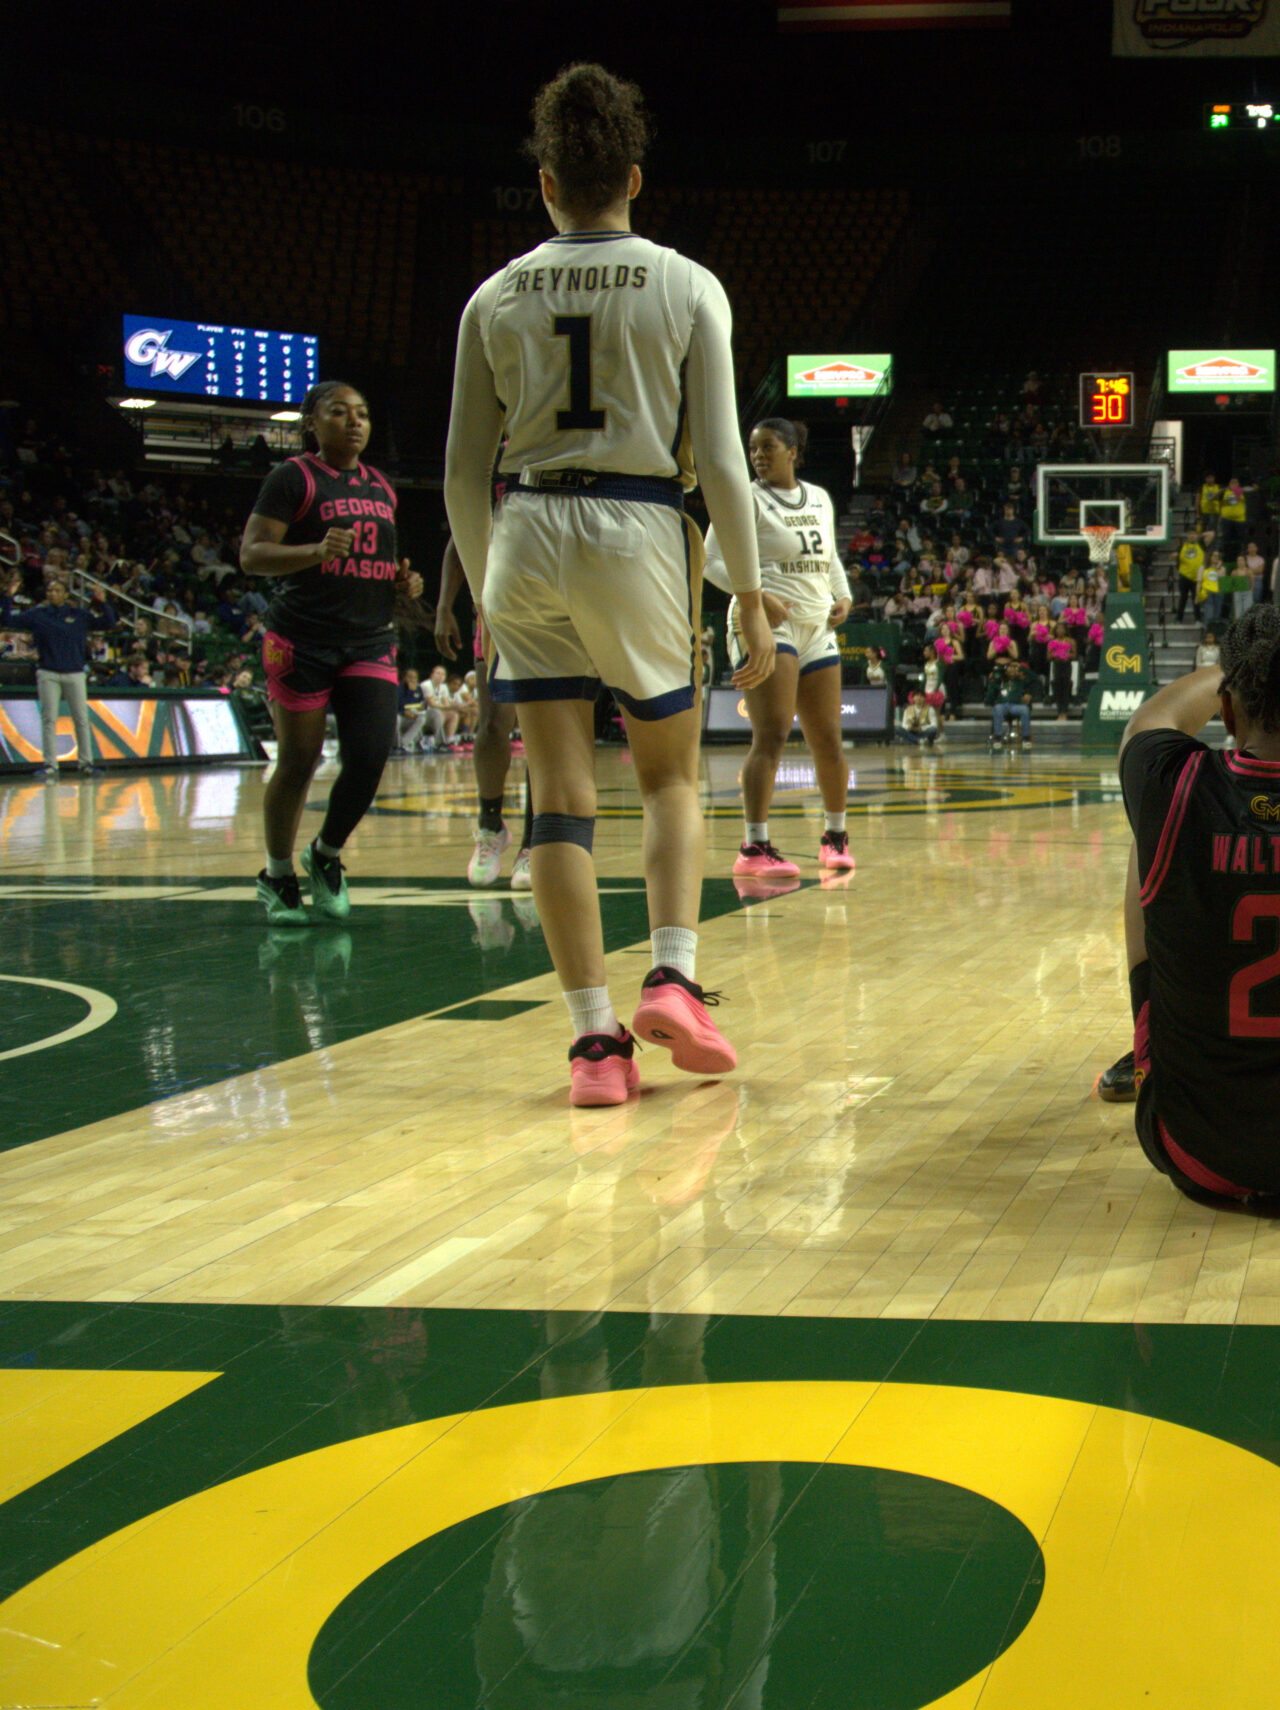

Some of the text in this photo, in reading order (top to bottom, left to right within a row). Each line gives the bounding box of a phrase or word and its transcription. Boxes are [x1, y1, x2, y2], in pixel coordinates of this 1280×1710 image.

[232, 102, 287, 133] 106
[804, 139, 848, 163] 107
[1076, 134, 1123, 158] 108
[492, 186, 540, 211] 107
[515, 265, 648, 293] REYNOLDS
[124, 328, 203, 381] GW
[551, 313, 608, 432] 1
[1096, 378, 1129, 395] 7:46
[1092, 394, 1124, 422] 30
[784, 515, 821, 527] GEORGE
[353, 520, 379, 554] 13
[795, 530, 824, 555] 12
[320, 557, 396, 581] MASON
[1105, 644, 1142, 673] GM
[1100, 690, 1145, 711] NW
